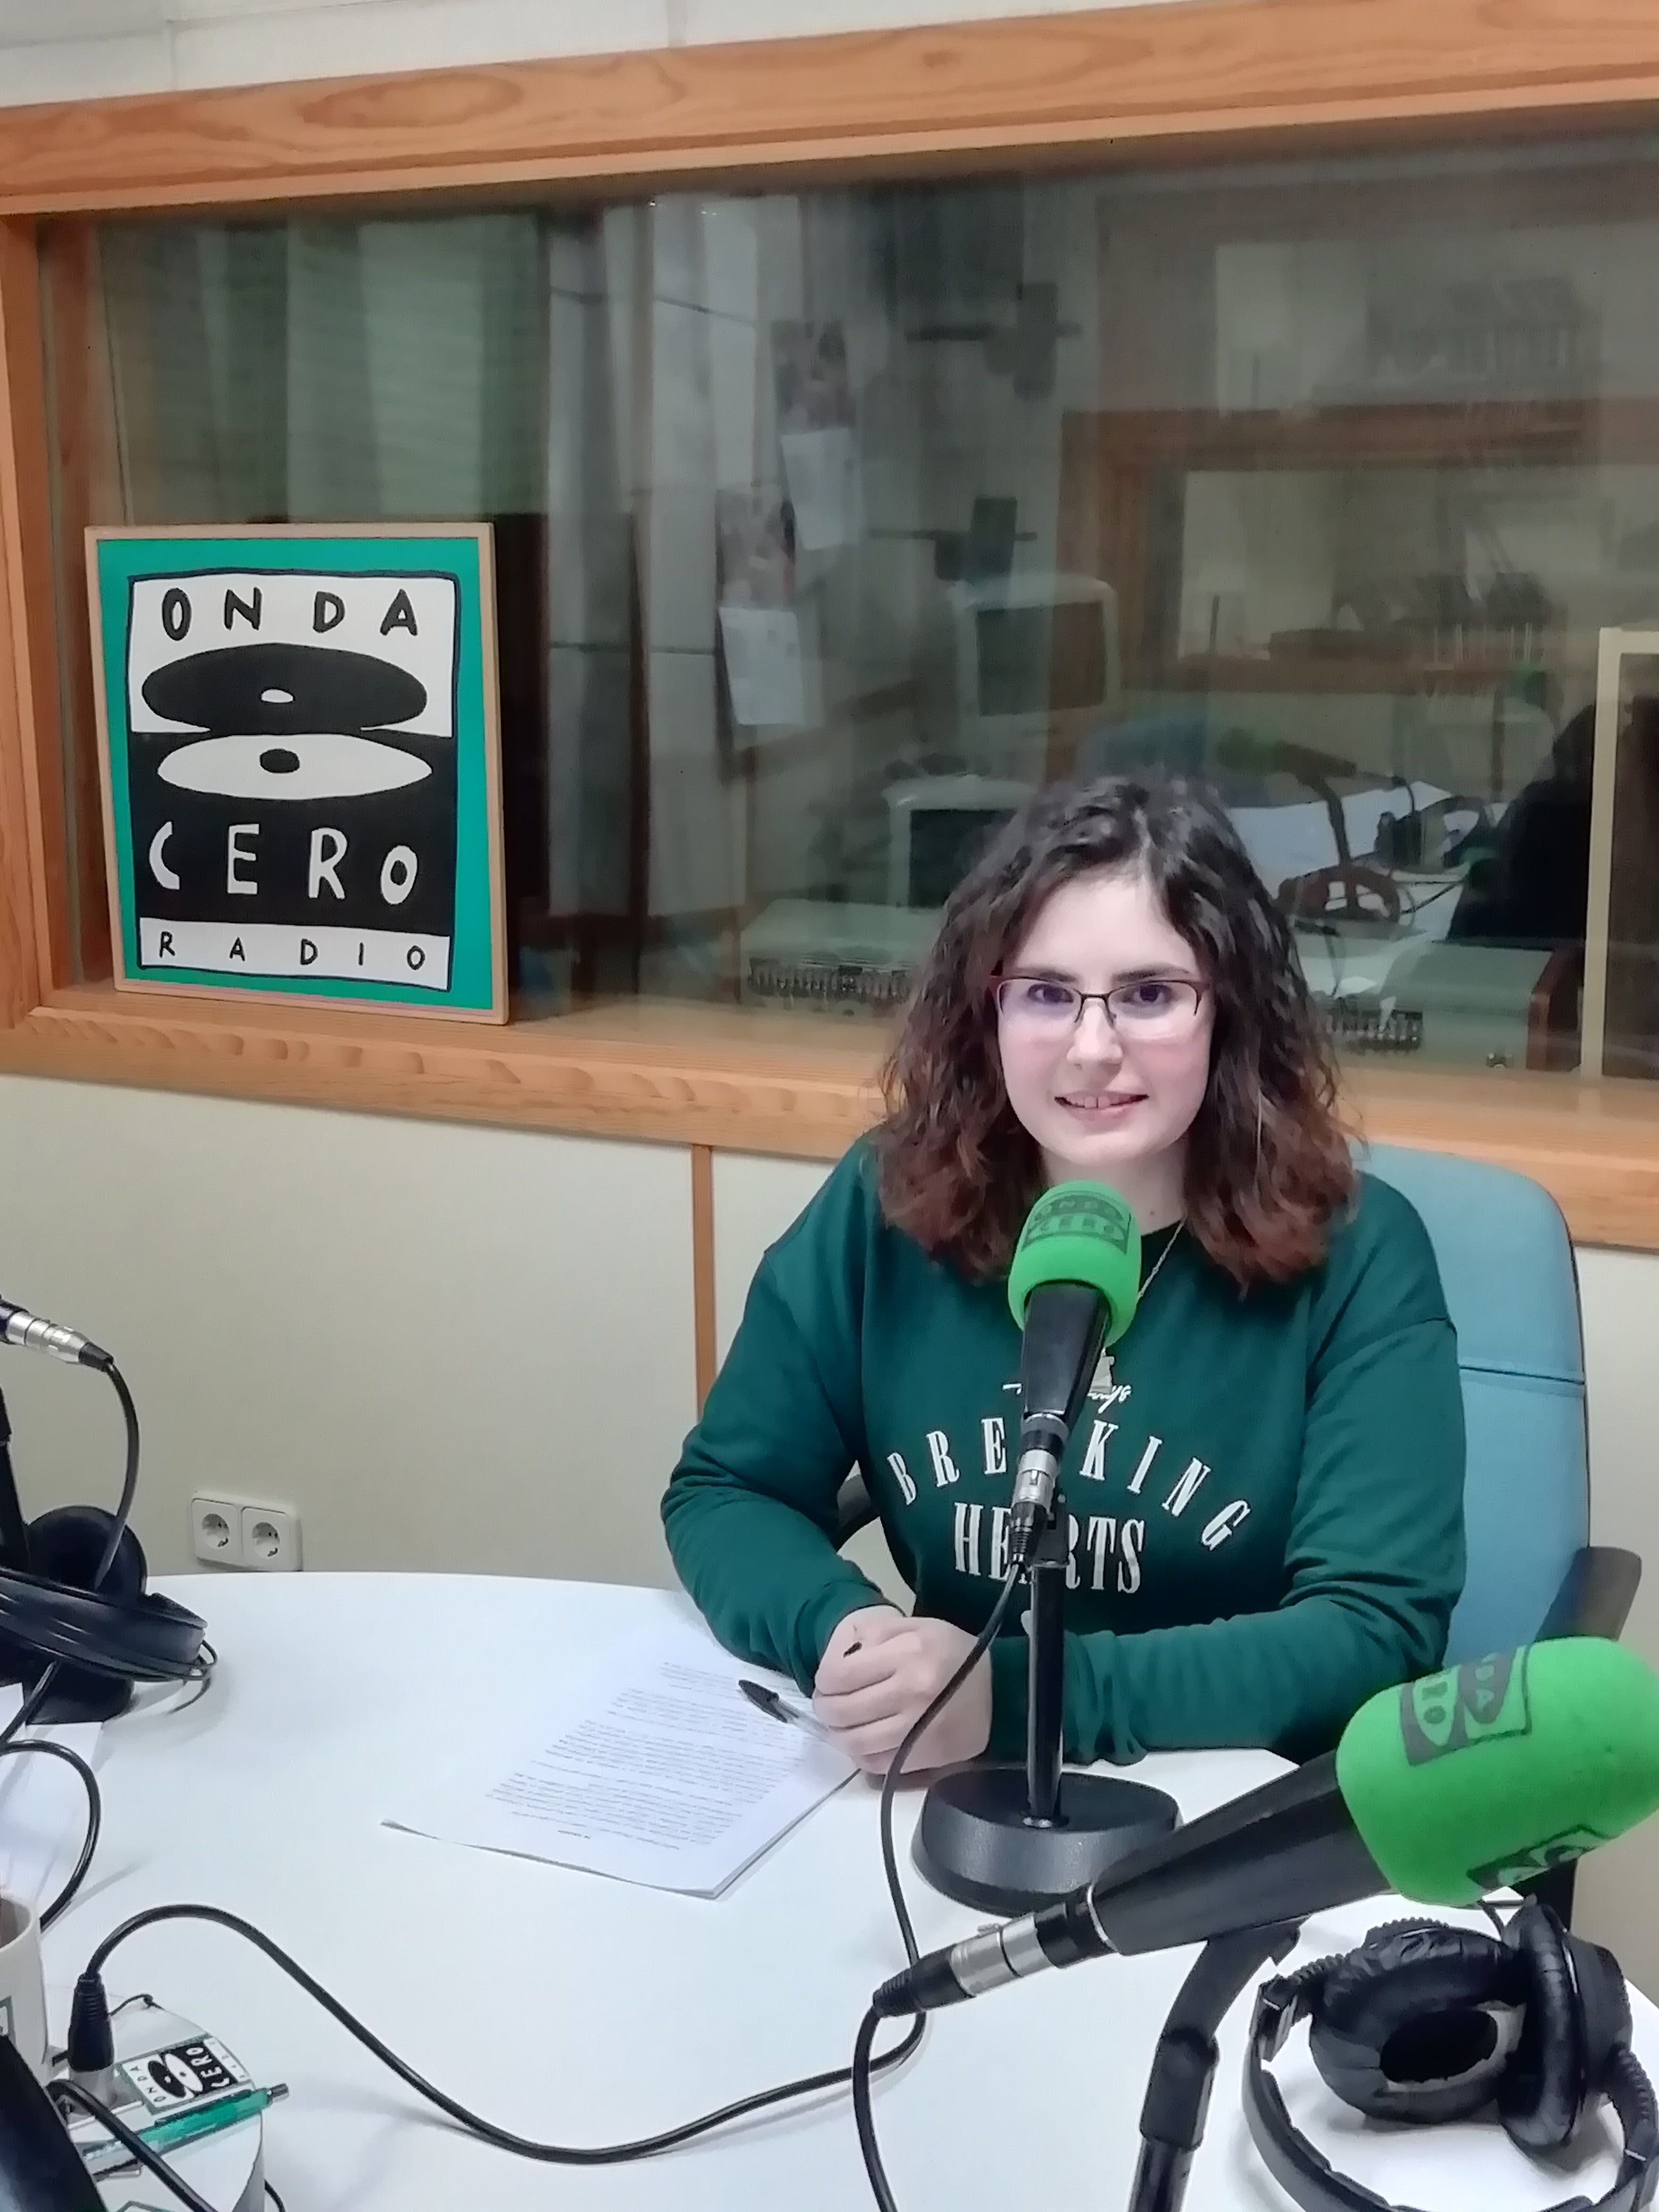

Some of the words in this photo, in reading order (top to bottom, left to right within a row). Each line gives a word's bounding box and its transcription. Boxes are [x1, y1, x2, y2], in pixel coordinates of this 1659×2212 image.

[162, 586, 417, 641] ONDA
[149, 820, 418, 906] CERO
[158, 932, 425, 970] RADIO
[887, 1417, 1251, 1551] BREKING
[954, 1502, 1145, 1594] HERTS
[129, 2065, 166, 2102] ONDA
[185, 2047, 230, 2088] CERO
